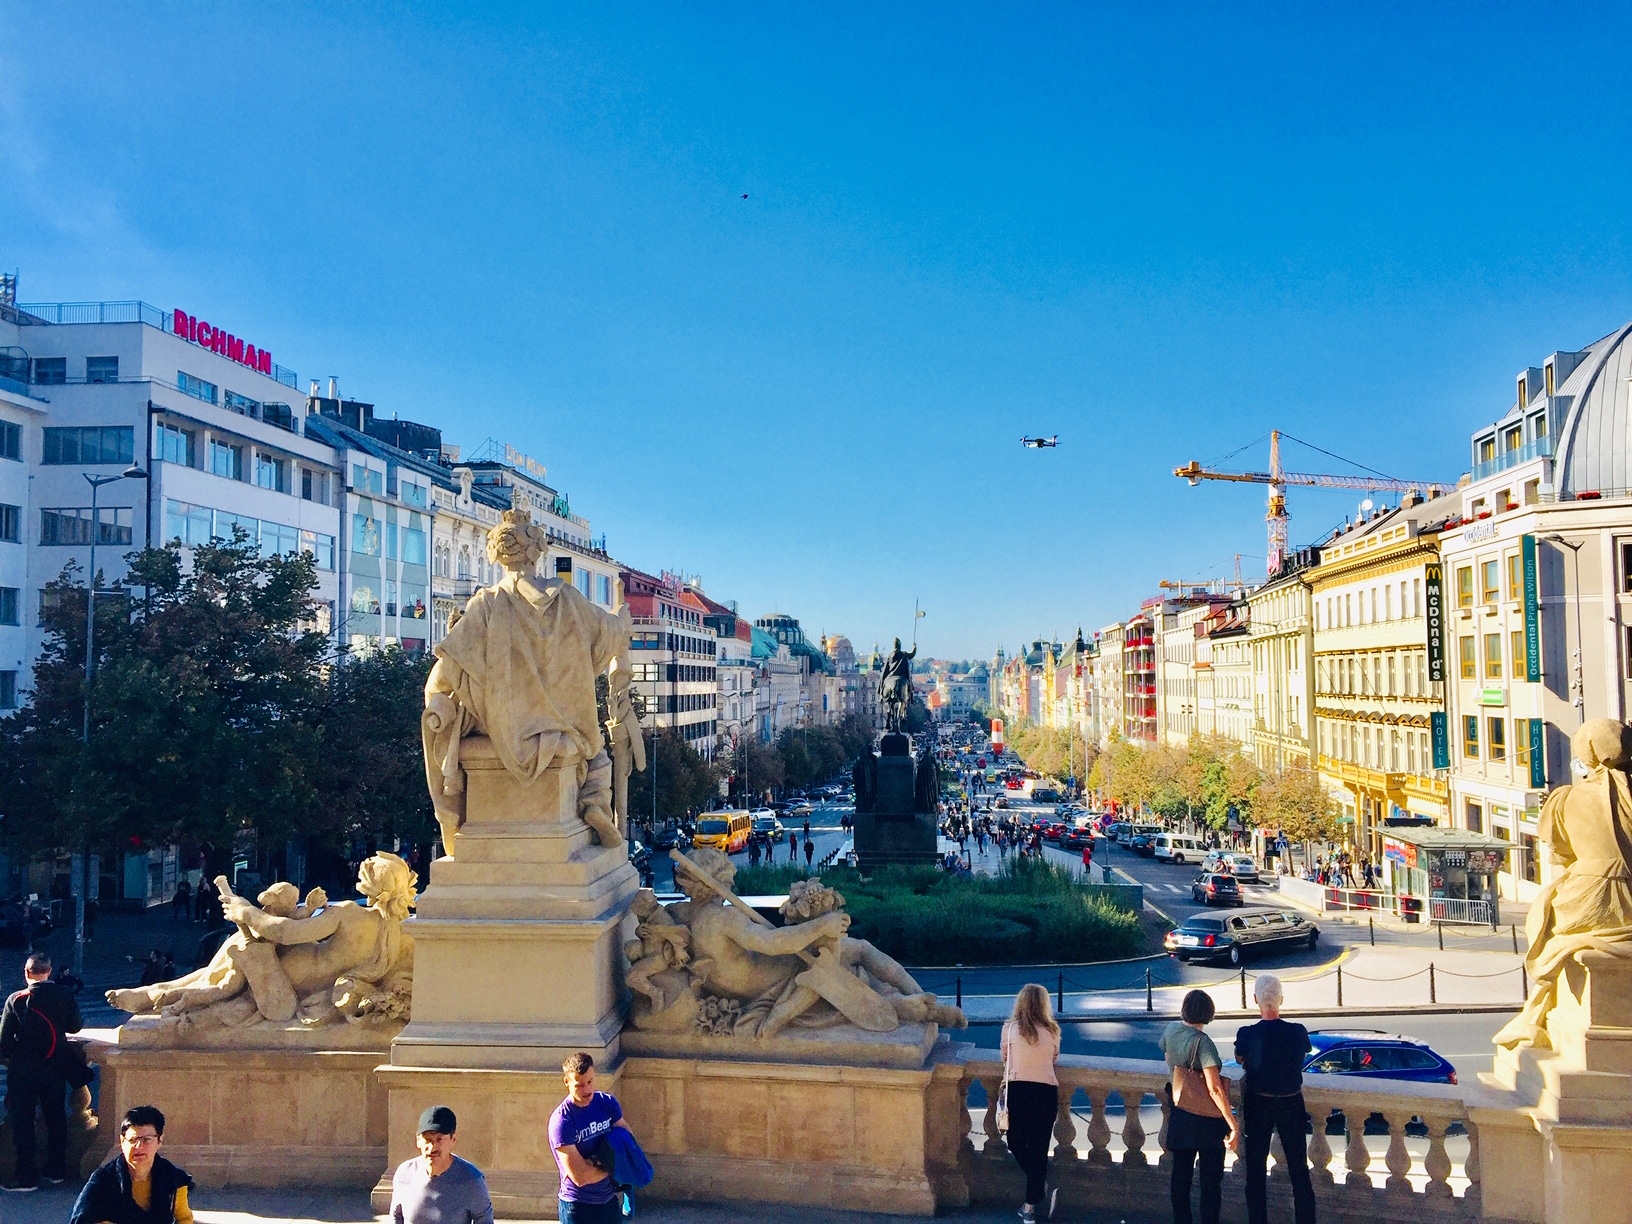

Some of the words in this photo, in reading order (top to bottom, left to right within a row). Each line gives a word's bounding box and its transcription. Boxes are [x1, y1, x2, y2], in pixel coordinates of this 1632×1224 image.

[174, 308, 271, 375] RICHMAN
[1526, 559, 1534, 591] Wilson
[1428, 585, 1443, 680] McDonald's
[1529, 623, 1537, 676] Occidental
[1435, 718, 1443, 765] HOTEL
[1532, 725, 1540, 782] HOTEL
